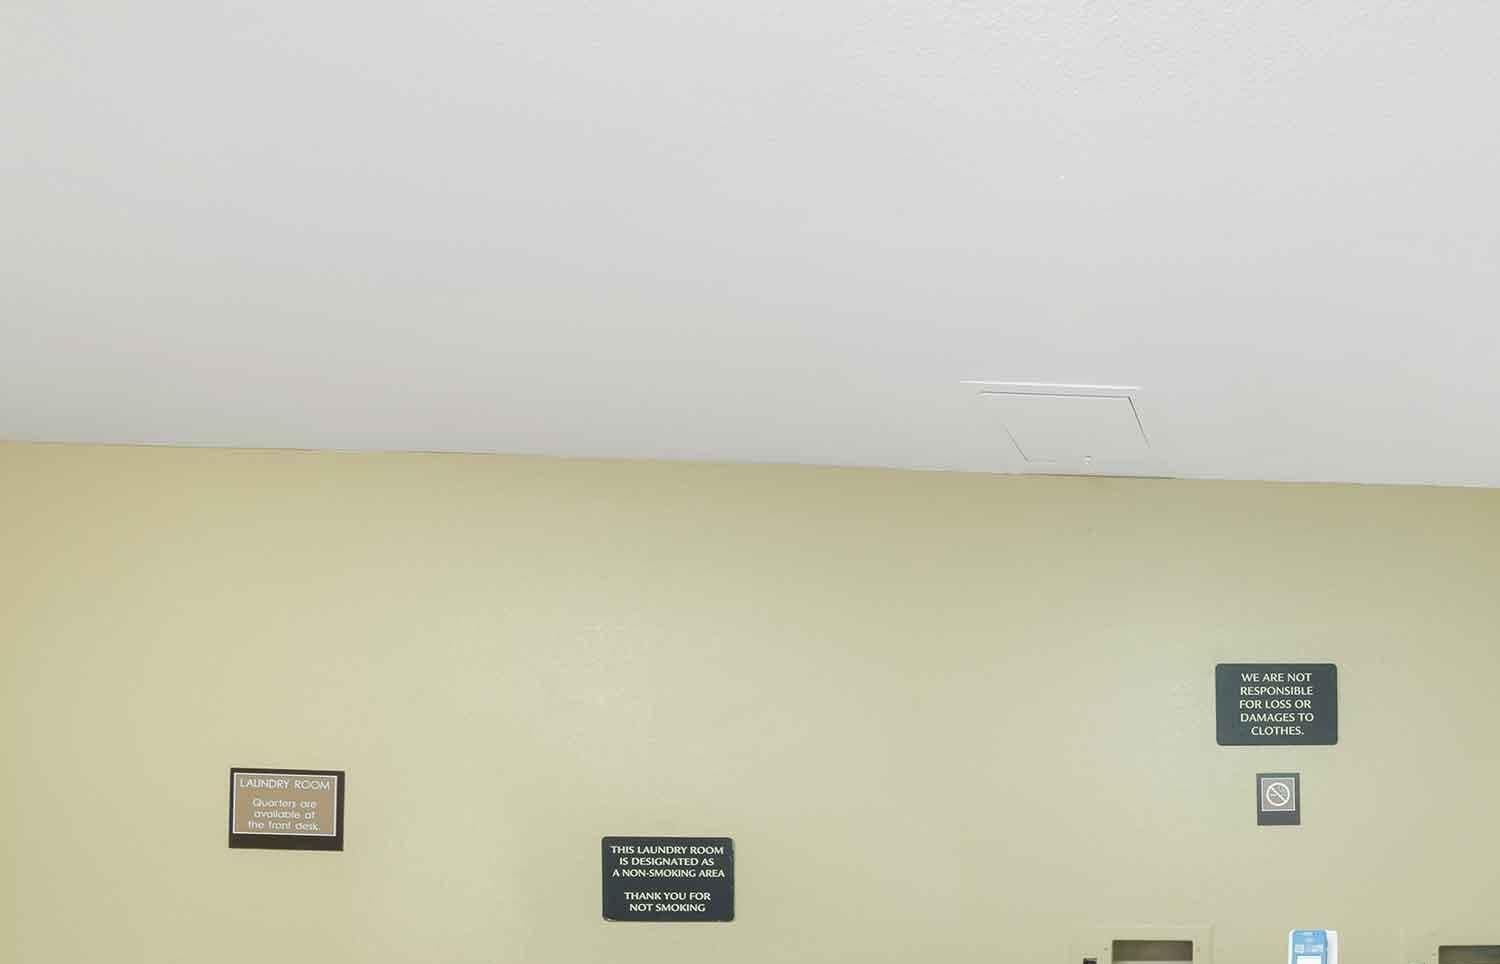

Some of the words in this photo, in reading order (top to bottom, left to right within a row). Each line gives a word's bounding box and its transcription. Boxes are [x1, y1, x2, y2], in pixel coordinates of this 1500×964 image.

[1241, 673, 1259, 682] WE
[1262, 673, 1284, 682] ARE
[1287, 673, 1312, 682] NOT
[1240, 686, 1313, 696] RESPONSIBLE
[1239, 700, 1262, 709] FOR
[1265, 700, 1292, 709] LOSS
[1294, 700, 1312, 709] OR
[1240, 713, 1295, 722] DAMAGES
[1297, 713, 1314, 722] TO
[1251, 726, 1304, 735] CLOTHES.
[240, 779, 289, 789] LAUNDRY
[294, 780, 330, 790] ROOM
[252, 799, 296, 809] Quarters
[300, 801, 317, 809] are
[254, 810, 300, 820] available
[304, 811, 316, 820] at
[248, 820, 265, 829] the
[268, 820, 291, 830] front
[611, 846, 635, 854] THIS
[637, 846, 687, 855] LAUNDRY
[690, 846, 725, 855] ROOM
[620, 857, 629, 866] IS
[632, 857, 699, 866] DESIGNATED
[701, 857, 715, 866] AS
[612, 869, 620, 877] A
[622, 869, 696, 878] NON-SMOKING
[699, 869, 725, 878] AREA
[624, 892, 662, 900] THANK
[664, 892, 687, 901] YOU
[689, 892, 711, 901] FOR
[629, 904, 653, 912] NOT
[655, 904, 706, 912] SMOKING
